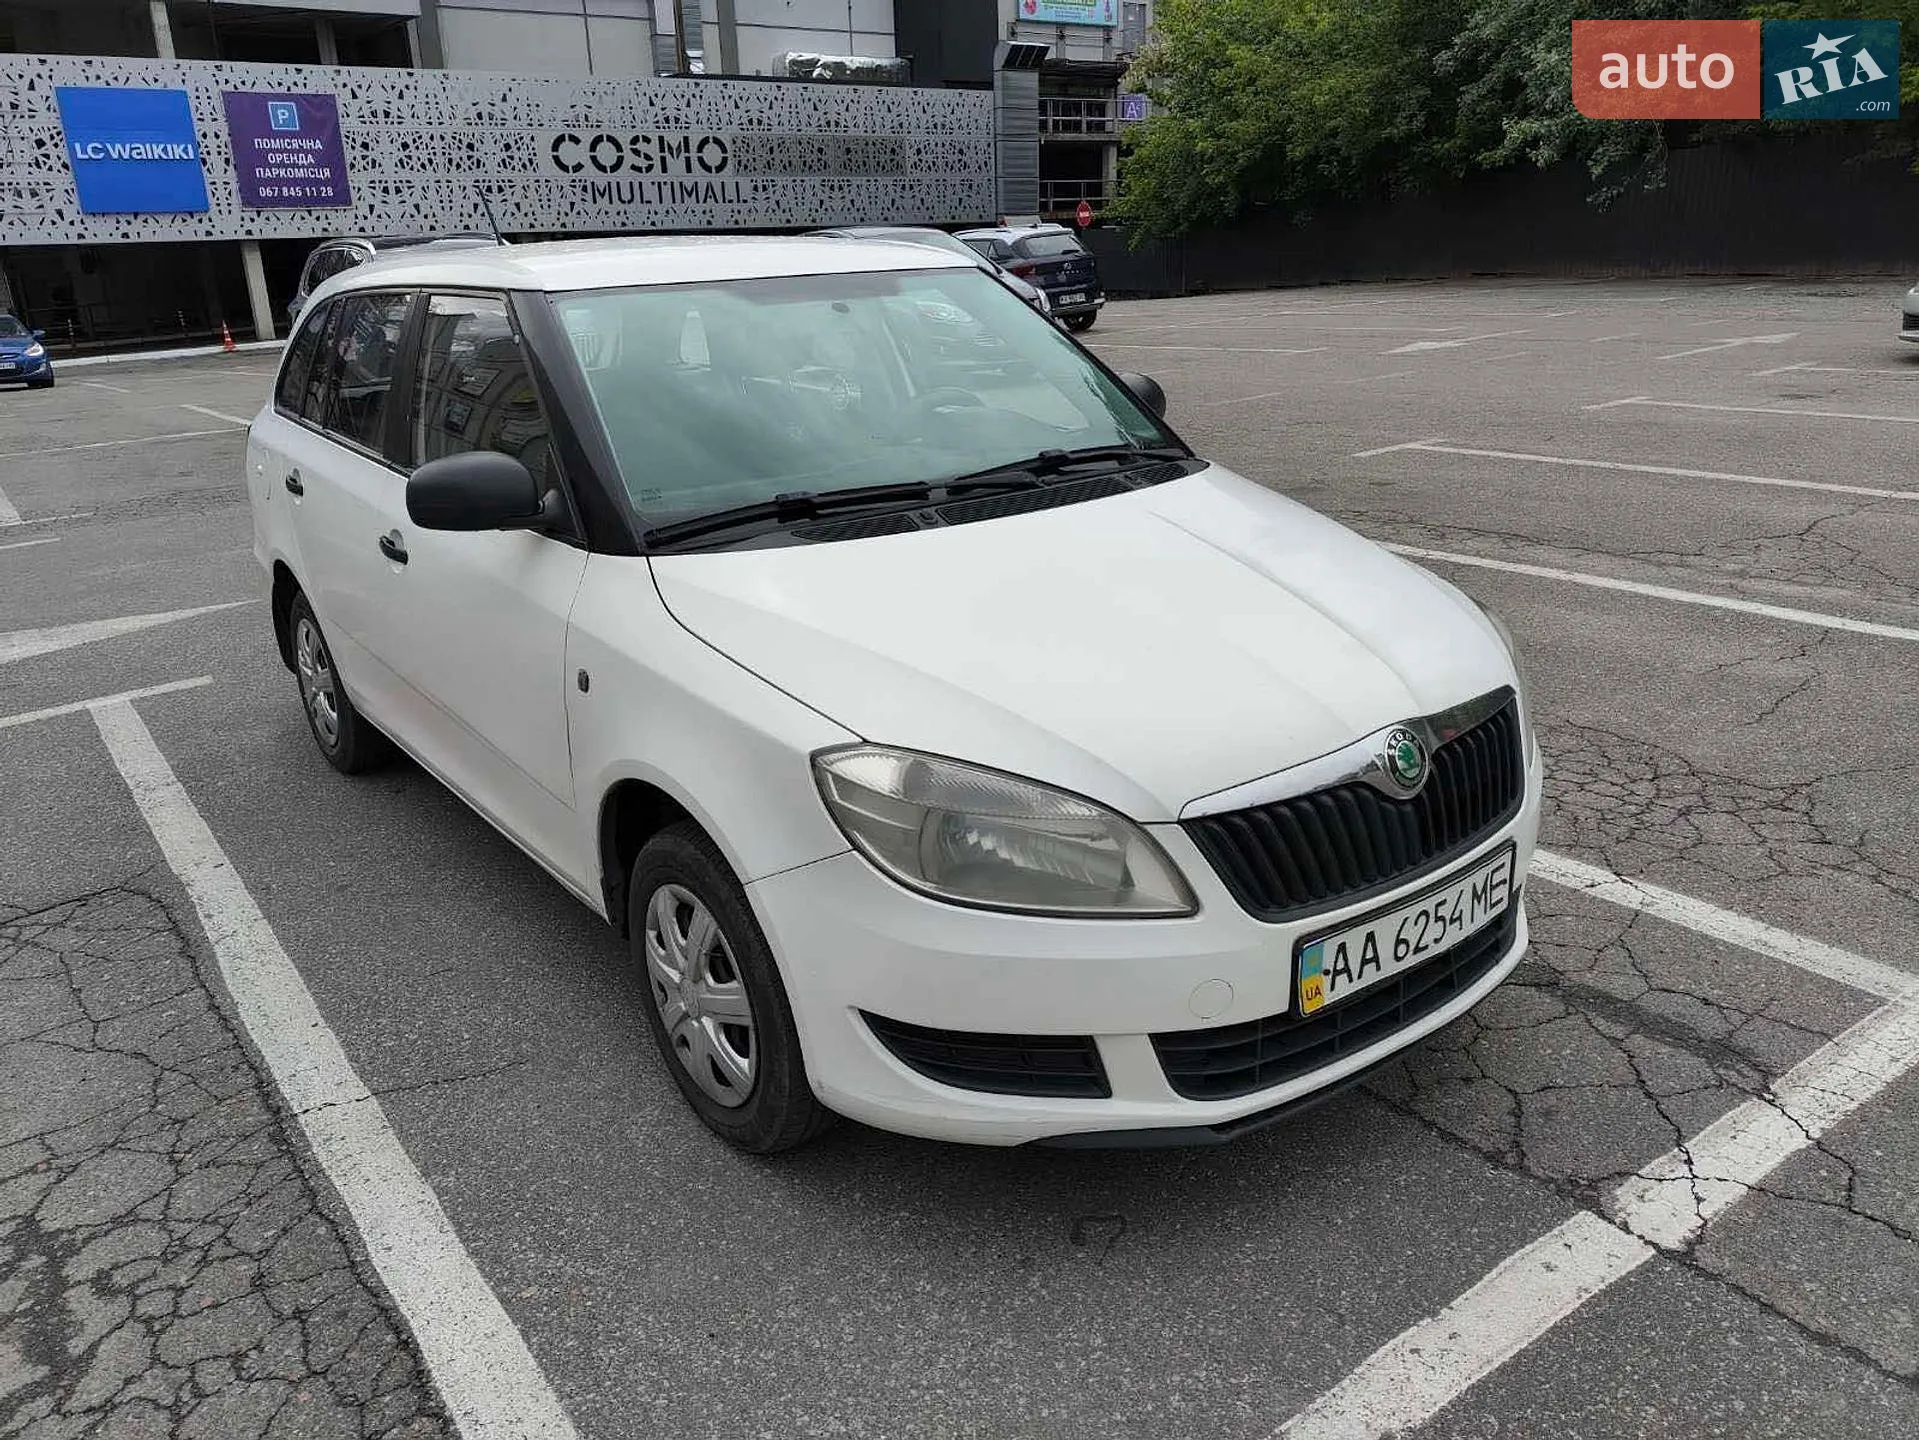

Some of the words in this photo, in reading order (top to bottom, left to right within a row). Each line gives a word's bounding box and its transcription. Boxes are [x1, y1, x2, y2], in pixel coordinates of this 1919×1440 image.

[277, 109, 289, 125] P
[75, 142, 105, 160] LC
[254, 138, 323, 150] ПОМІСЯЧНА
[267, 153, 315, 166] ОРЕНДА
[551, 133, 729, 174] COSMO
[255, 167, 331, 180] ПАРКОМІСЦЯ
[259, 187, 279, 197] 067
[282, 186, 303, 197] 845
[305, 187, 318, 197] 11
[320, 186, 334, 197] 28
[590, 181, 748, 204] MULTIMALL
[1329, 930, 1382, 992] AA
[1393, 889, 1464, 963] 6254
[1470, 861, 1508, 924] ME
[1305, 984, 1323, 1001] UA
